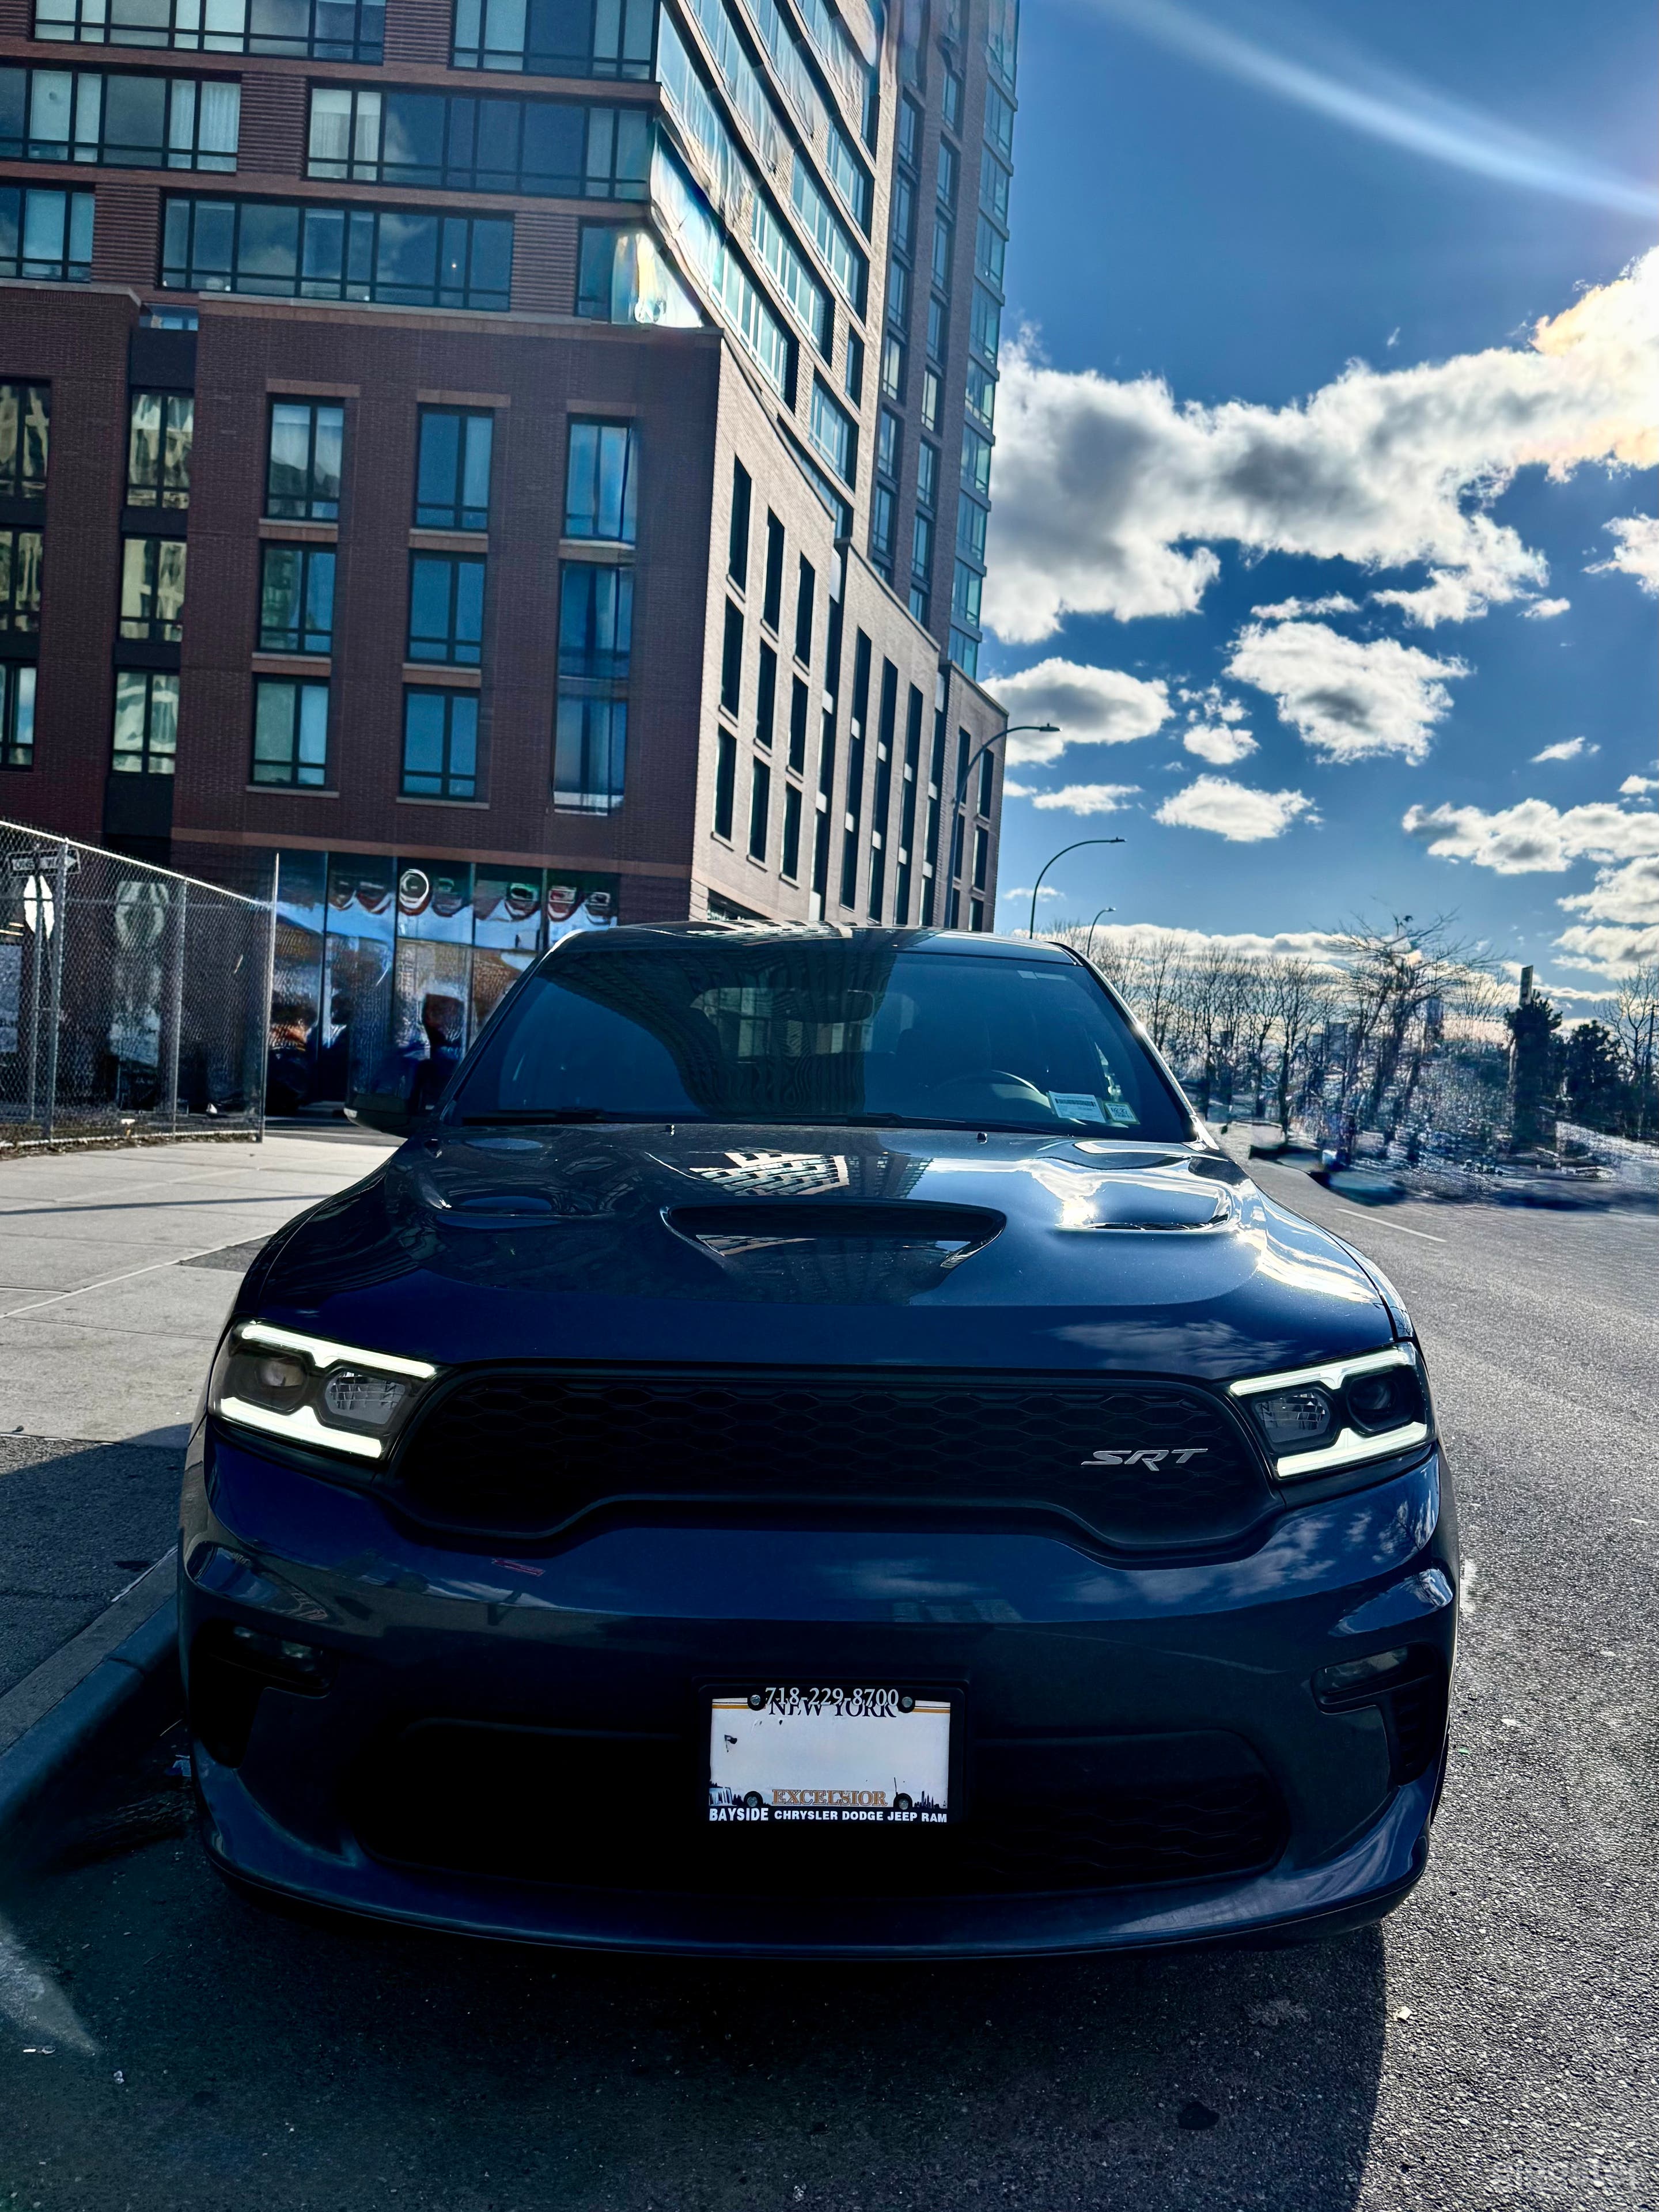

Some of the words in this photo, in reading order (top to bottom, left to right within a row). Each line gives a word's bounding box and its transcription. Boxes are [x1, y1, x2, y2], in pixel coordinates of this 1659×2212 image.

[1081, 1448, 1209, 1471] SRT
[764, 1687, 899, 1707] 718-229-8700
[767, 1698, 823, 1716] NEW
[834, 1699, 897, 1718] YORK
[772, 1789, 888, 1807] EXCELSIOR
[709, 1808, 769, 1821] BAYSIDE
[774, 1810, 838, 1820] CHRYSLER
[842, 1811, 884, 1821] DODGE
[887, 1812, 918, 1821] JEEP
[921, 1813, 947, 1823] RAM
